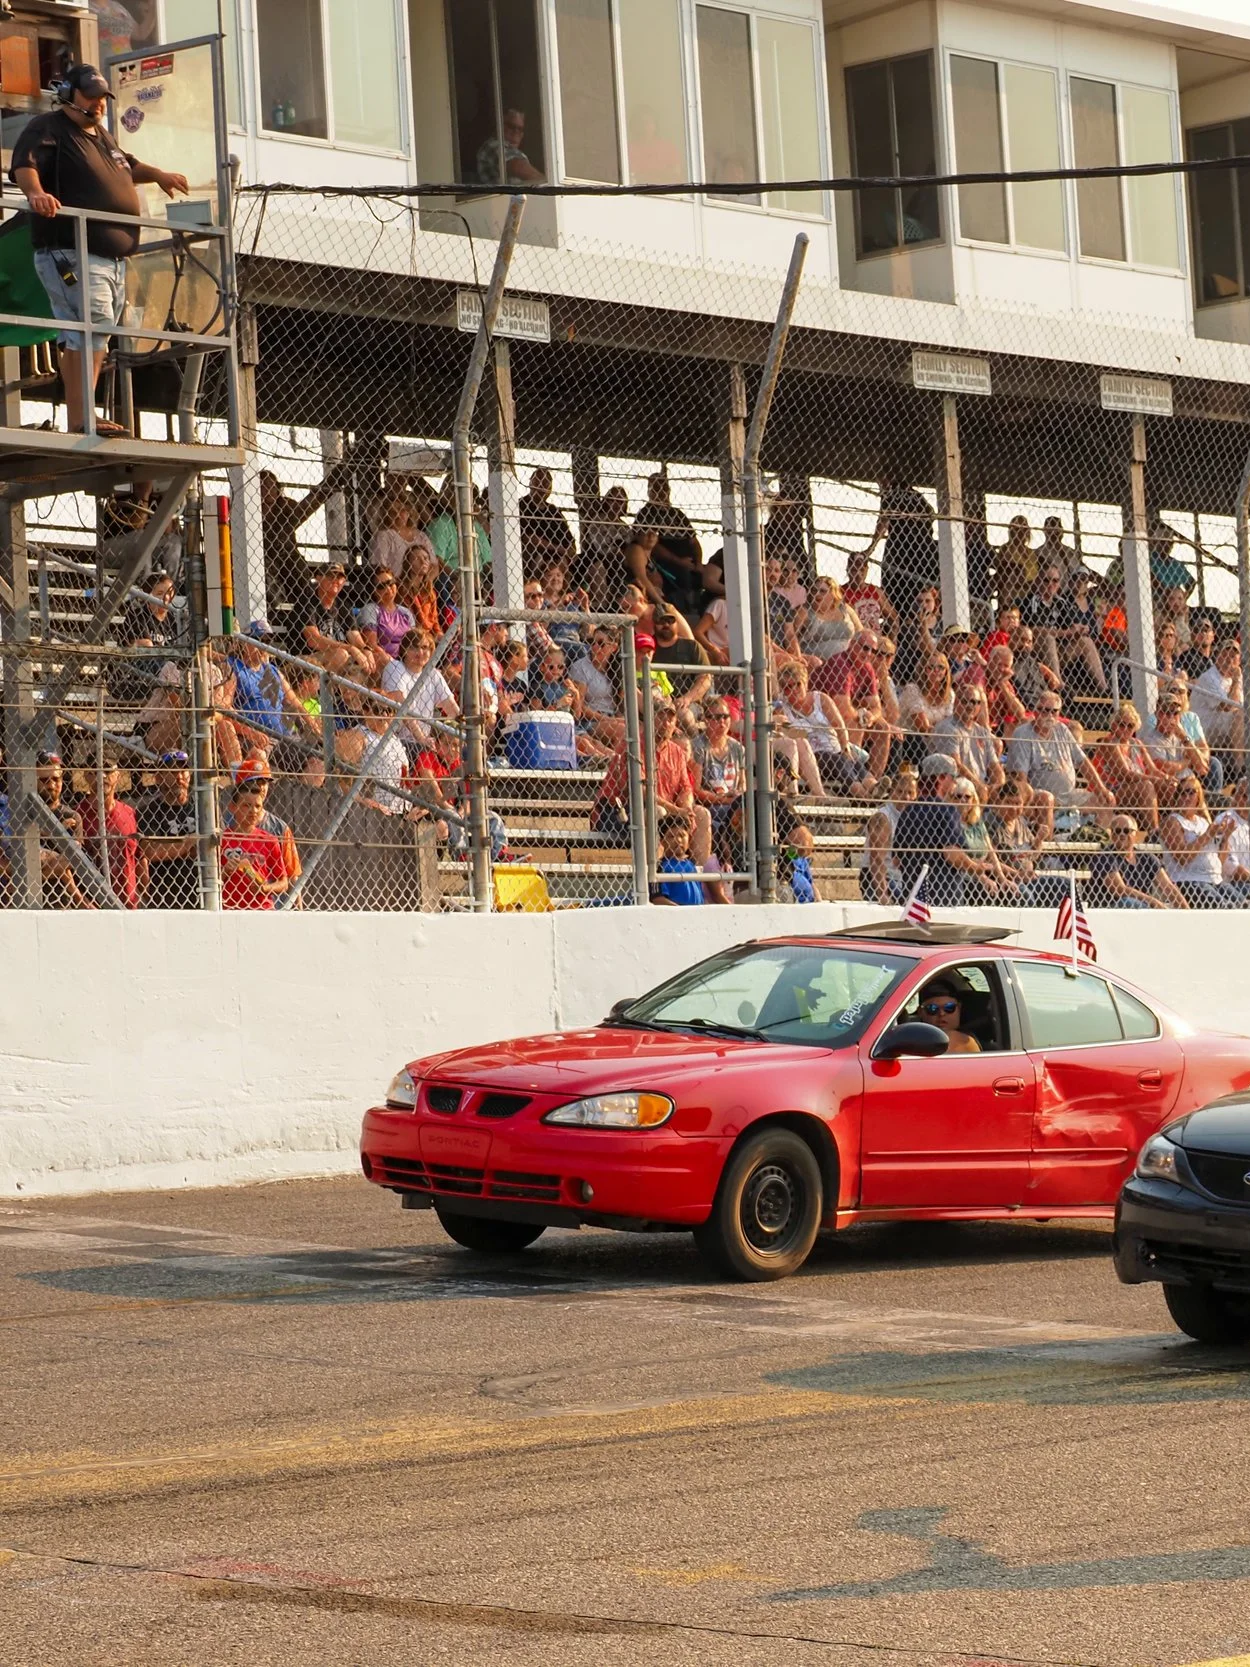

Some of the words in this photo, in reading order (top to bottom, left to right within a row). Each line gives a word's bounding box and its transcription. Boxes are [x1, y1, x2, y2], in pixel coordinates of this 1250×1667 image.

[501, 300, 546, 322] SECTION
[461, 314, 471, 323] NO
[509, 320, 518, 330] NO
[916, 355, 949, 373] FAMILY
[950, 358, 986, 377] SECTION
[1103, 379, 1134, 394] FAMILY
[1134, 381, 1170, 398] SECTION
[428, 1134, 480, 1149] PONTIAC
